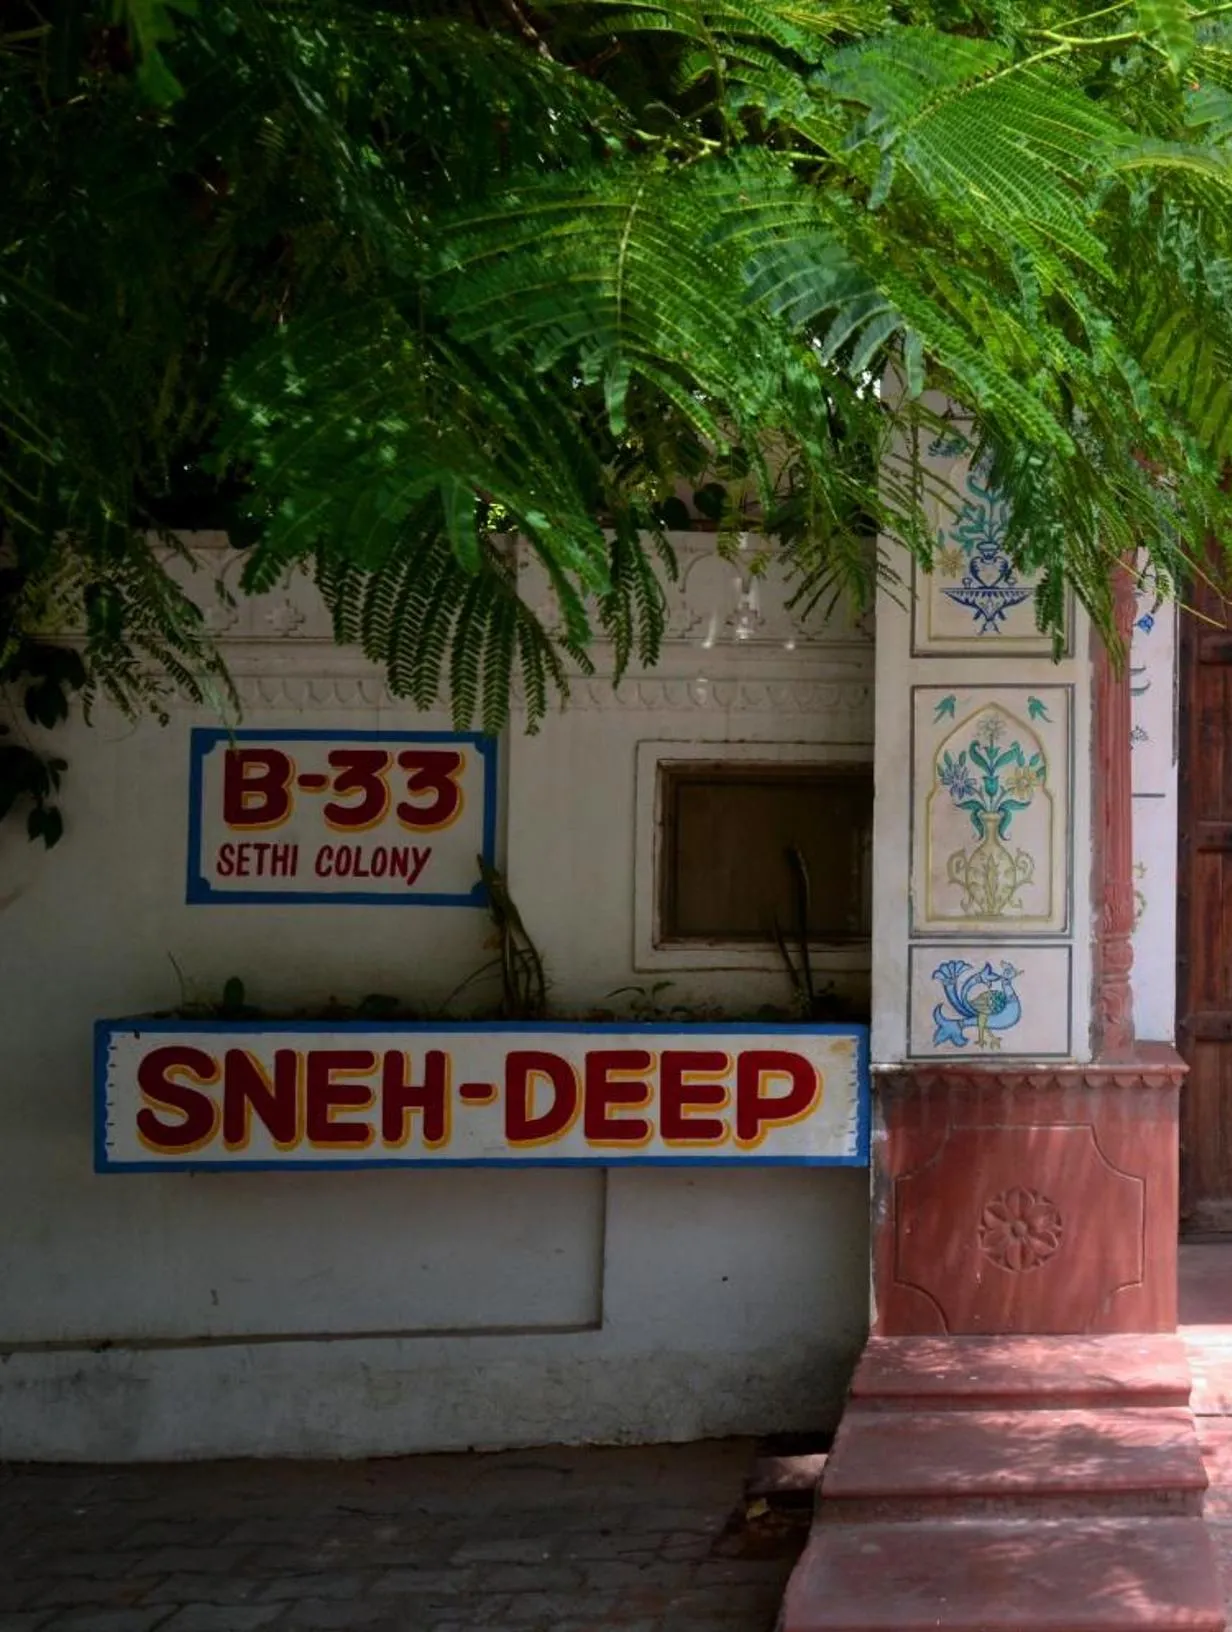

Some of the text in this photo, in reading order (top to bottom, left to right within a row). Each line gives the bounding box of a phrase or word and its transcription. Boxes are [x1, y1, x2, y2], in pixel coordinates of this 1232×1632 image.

[223, 748, 465, 833] B-33
[216, 842, 432, 886] SETHI COLONY
[136, 1045, 823, 1152] SNEH-DEEP
